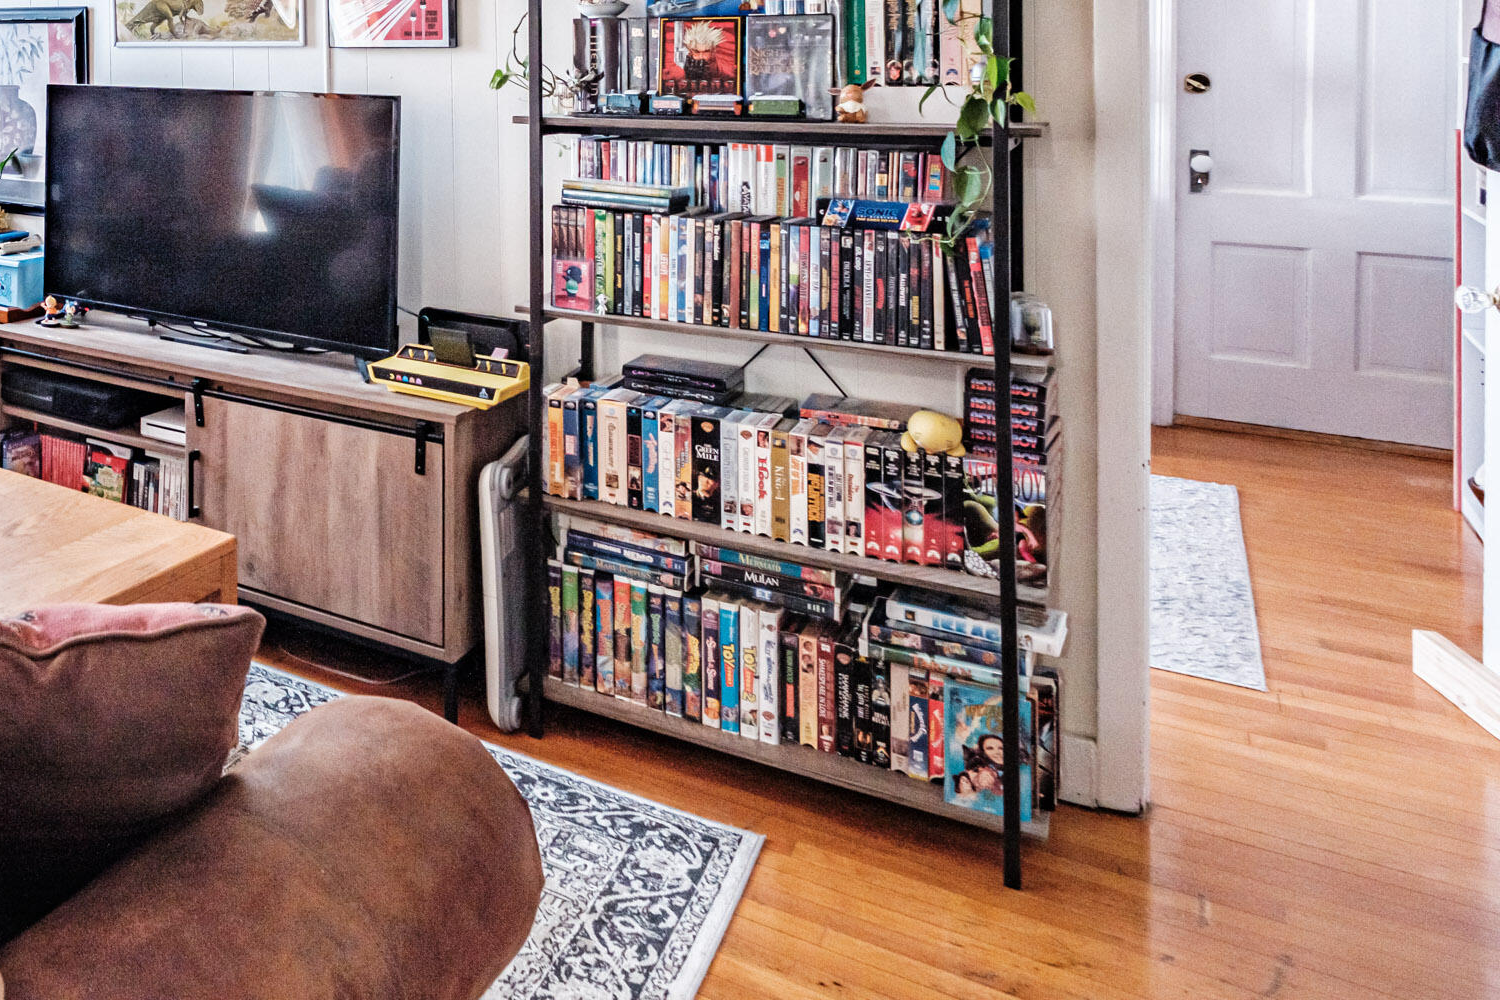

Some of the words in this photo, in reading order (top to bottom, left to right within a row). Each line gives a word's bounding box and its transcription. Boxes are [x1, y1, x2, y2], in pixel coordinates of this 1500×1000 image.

[855, 207, 897, 216] SONIC
[843, 261, 851, 288] DRACULA
[899, 273, 907, 306] HALLOWEEN
[694, 445, 720, 456] GREEN
[696, 452, 720, 461] MILE
[757, 456, 769, 500] Hook
[622, 549, 654, 563] NEMO
[739, 553, 781, 573] MERMAID
[744, 571, 780, 587] MULAN
[722, 643, 735, 668] TOY
[743, 646, 757, 673] TOY
[818, 658, 827, 695] SHAKESPEARE
[742, 692, 756, 704] 2
